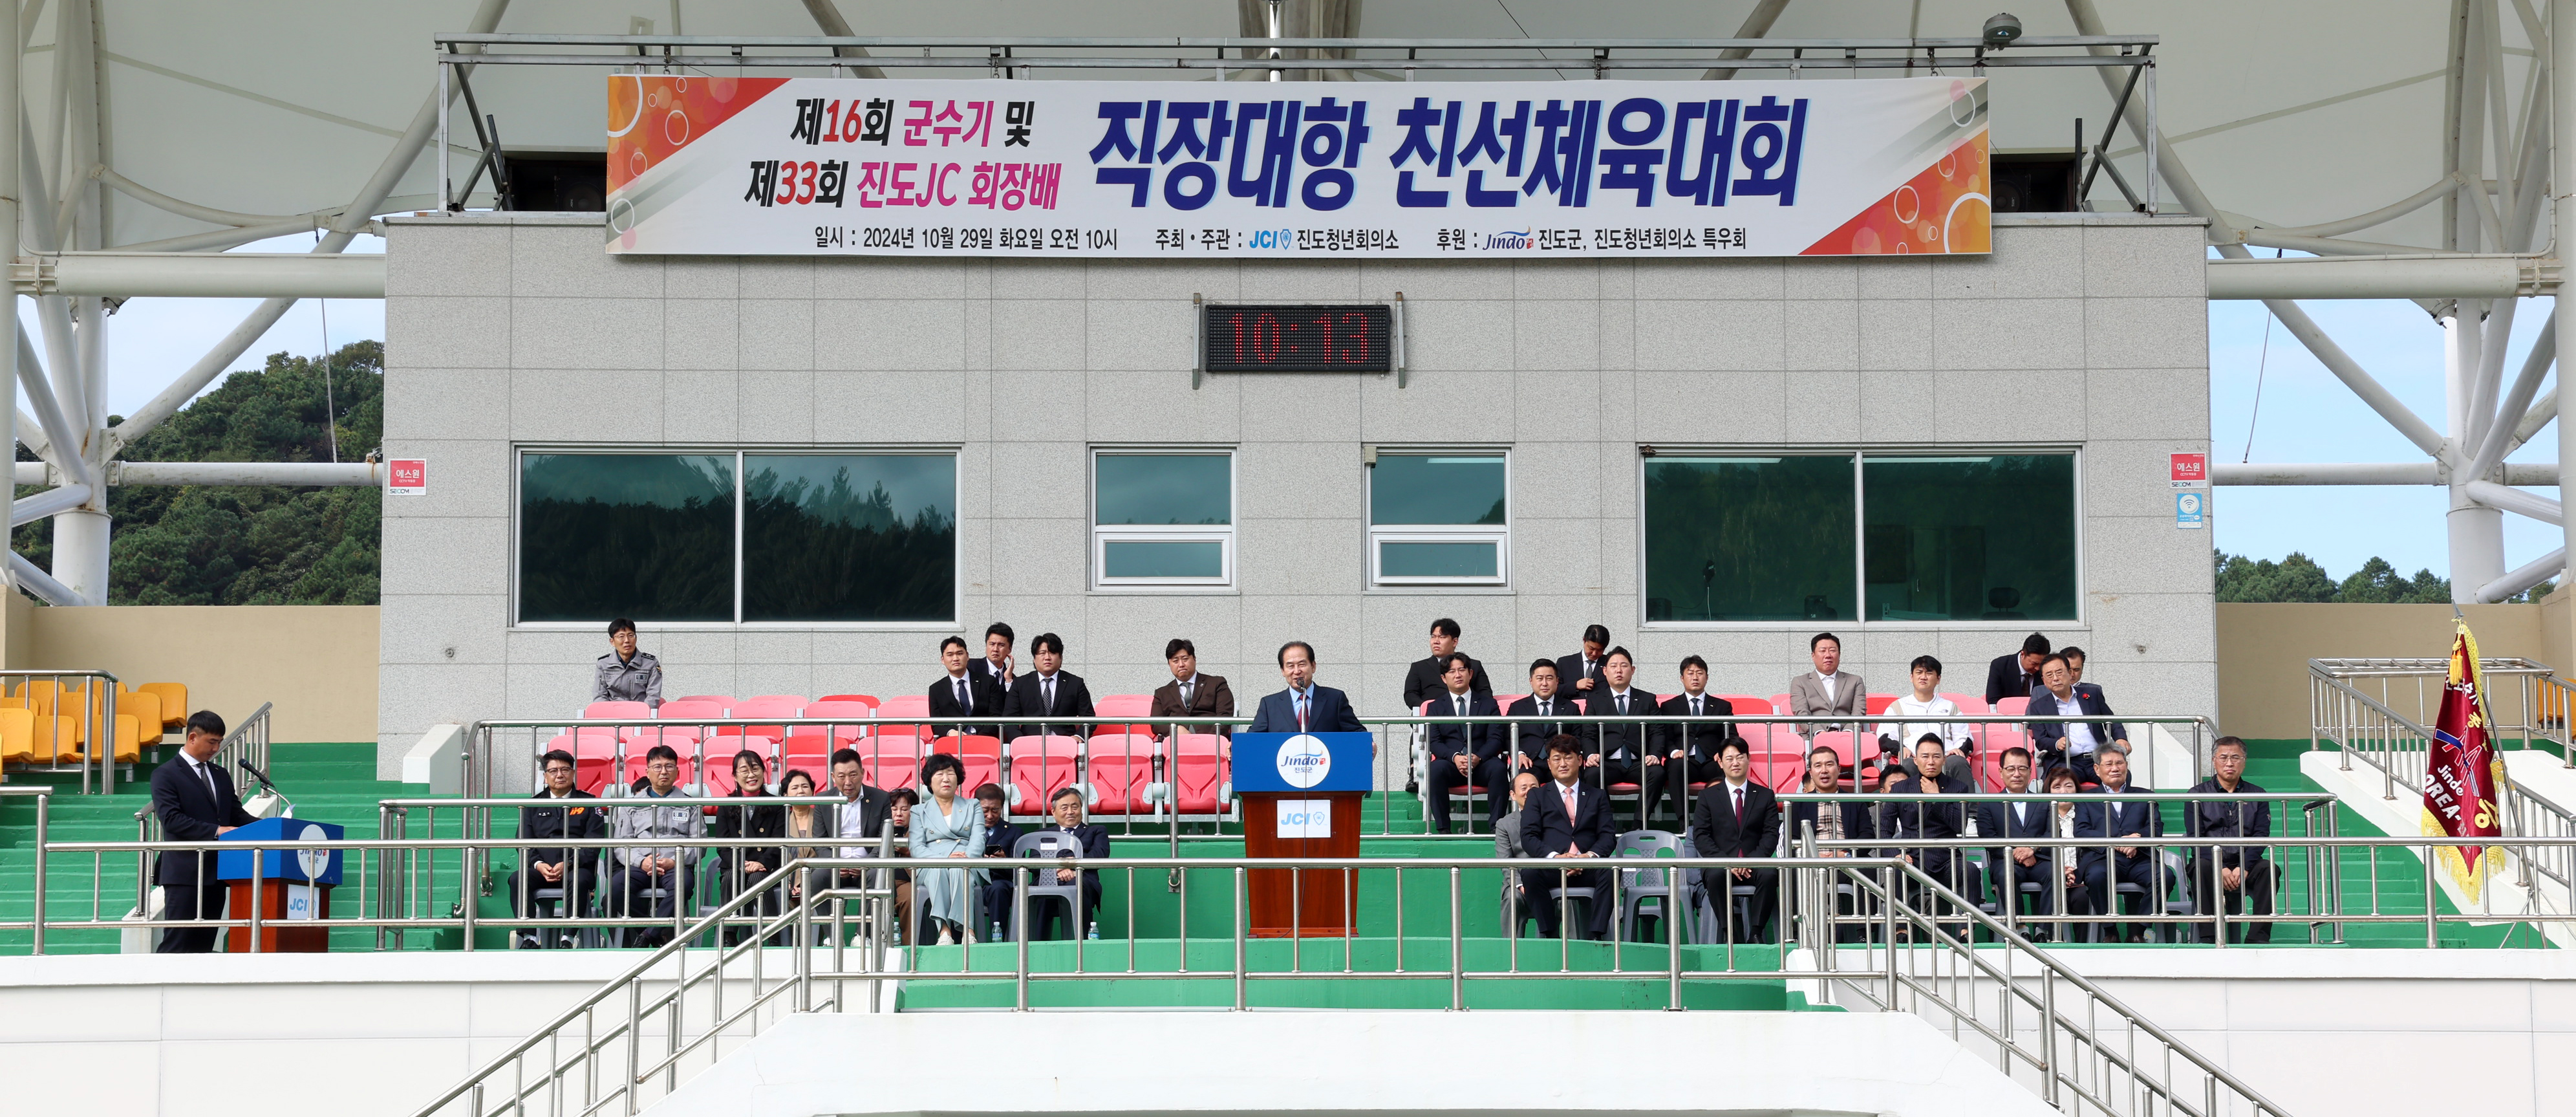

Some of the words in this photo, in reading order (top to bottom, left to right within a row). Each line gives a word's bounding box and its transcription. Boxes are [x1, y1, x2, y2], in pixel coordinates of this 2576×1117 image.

[790, 98, 894, 146] 제16회
[904, 100, 994, 147] 군수기
[1005, 101, 1035, 147] 및
[1089, 97, 1370, 211] 직장대항
[1390, 96, 1812, 208] 친선체육대회
[744, 160, 848, 208] 제33회
[857, 162, 961, 209] 진도JC
[968, 162, 1062, 210] 회장배
[815, 226, 843, 248] 일시
[864, 228, 914, 248] 2024년
[923, 227, 953, 249] 10월
[961, 228, 992, 249] 29일
[1000, 228, 1042, 249] 화요일
[1050, 228, 1078, 249] 오전
[1086, 229, 1117, 250] 10시
[1156, 228, 1183, 250] 주최
[1201, 229, 1230, 250] 주관
[1249, 230, 1278, 248] JCI
[1298, 228, 1399, 251] 진도청년회의소
[1437, 228, 1465, 250] 후원
[1483, 234, 1525, 250] Jindo
[1539, 229, 1587, 251] 진도군,
[1594, 228, 1696, 250] 진도청년회의소
[1703, 228, 1746, 250] 특우회
[1229, 312, 1368, 363] 10:13
[396, 469, 420, 479] 에스원
[2176, 462, 2200, 472] 에스원
[1281, 755, 1318, 766] Jindo
[1281, 813, 1310, 825] JCI
[289, 898, 307, 912] JCI
